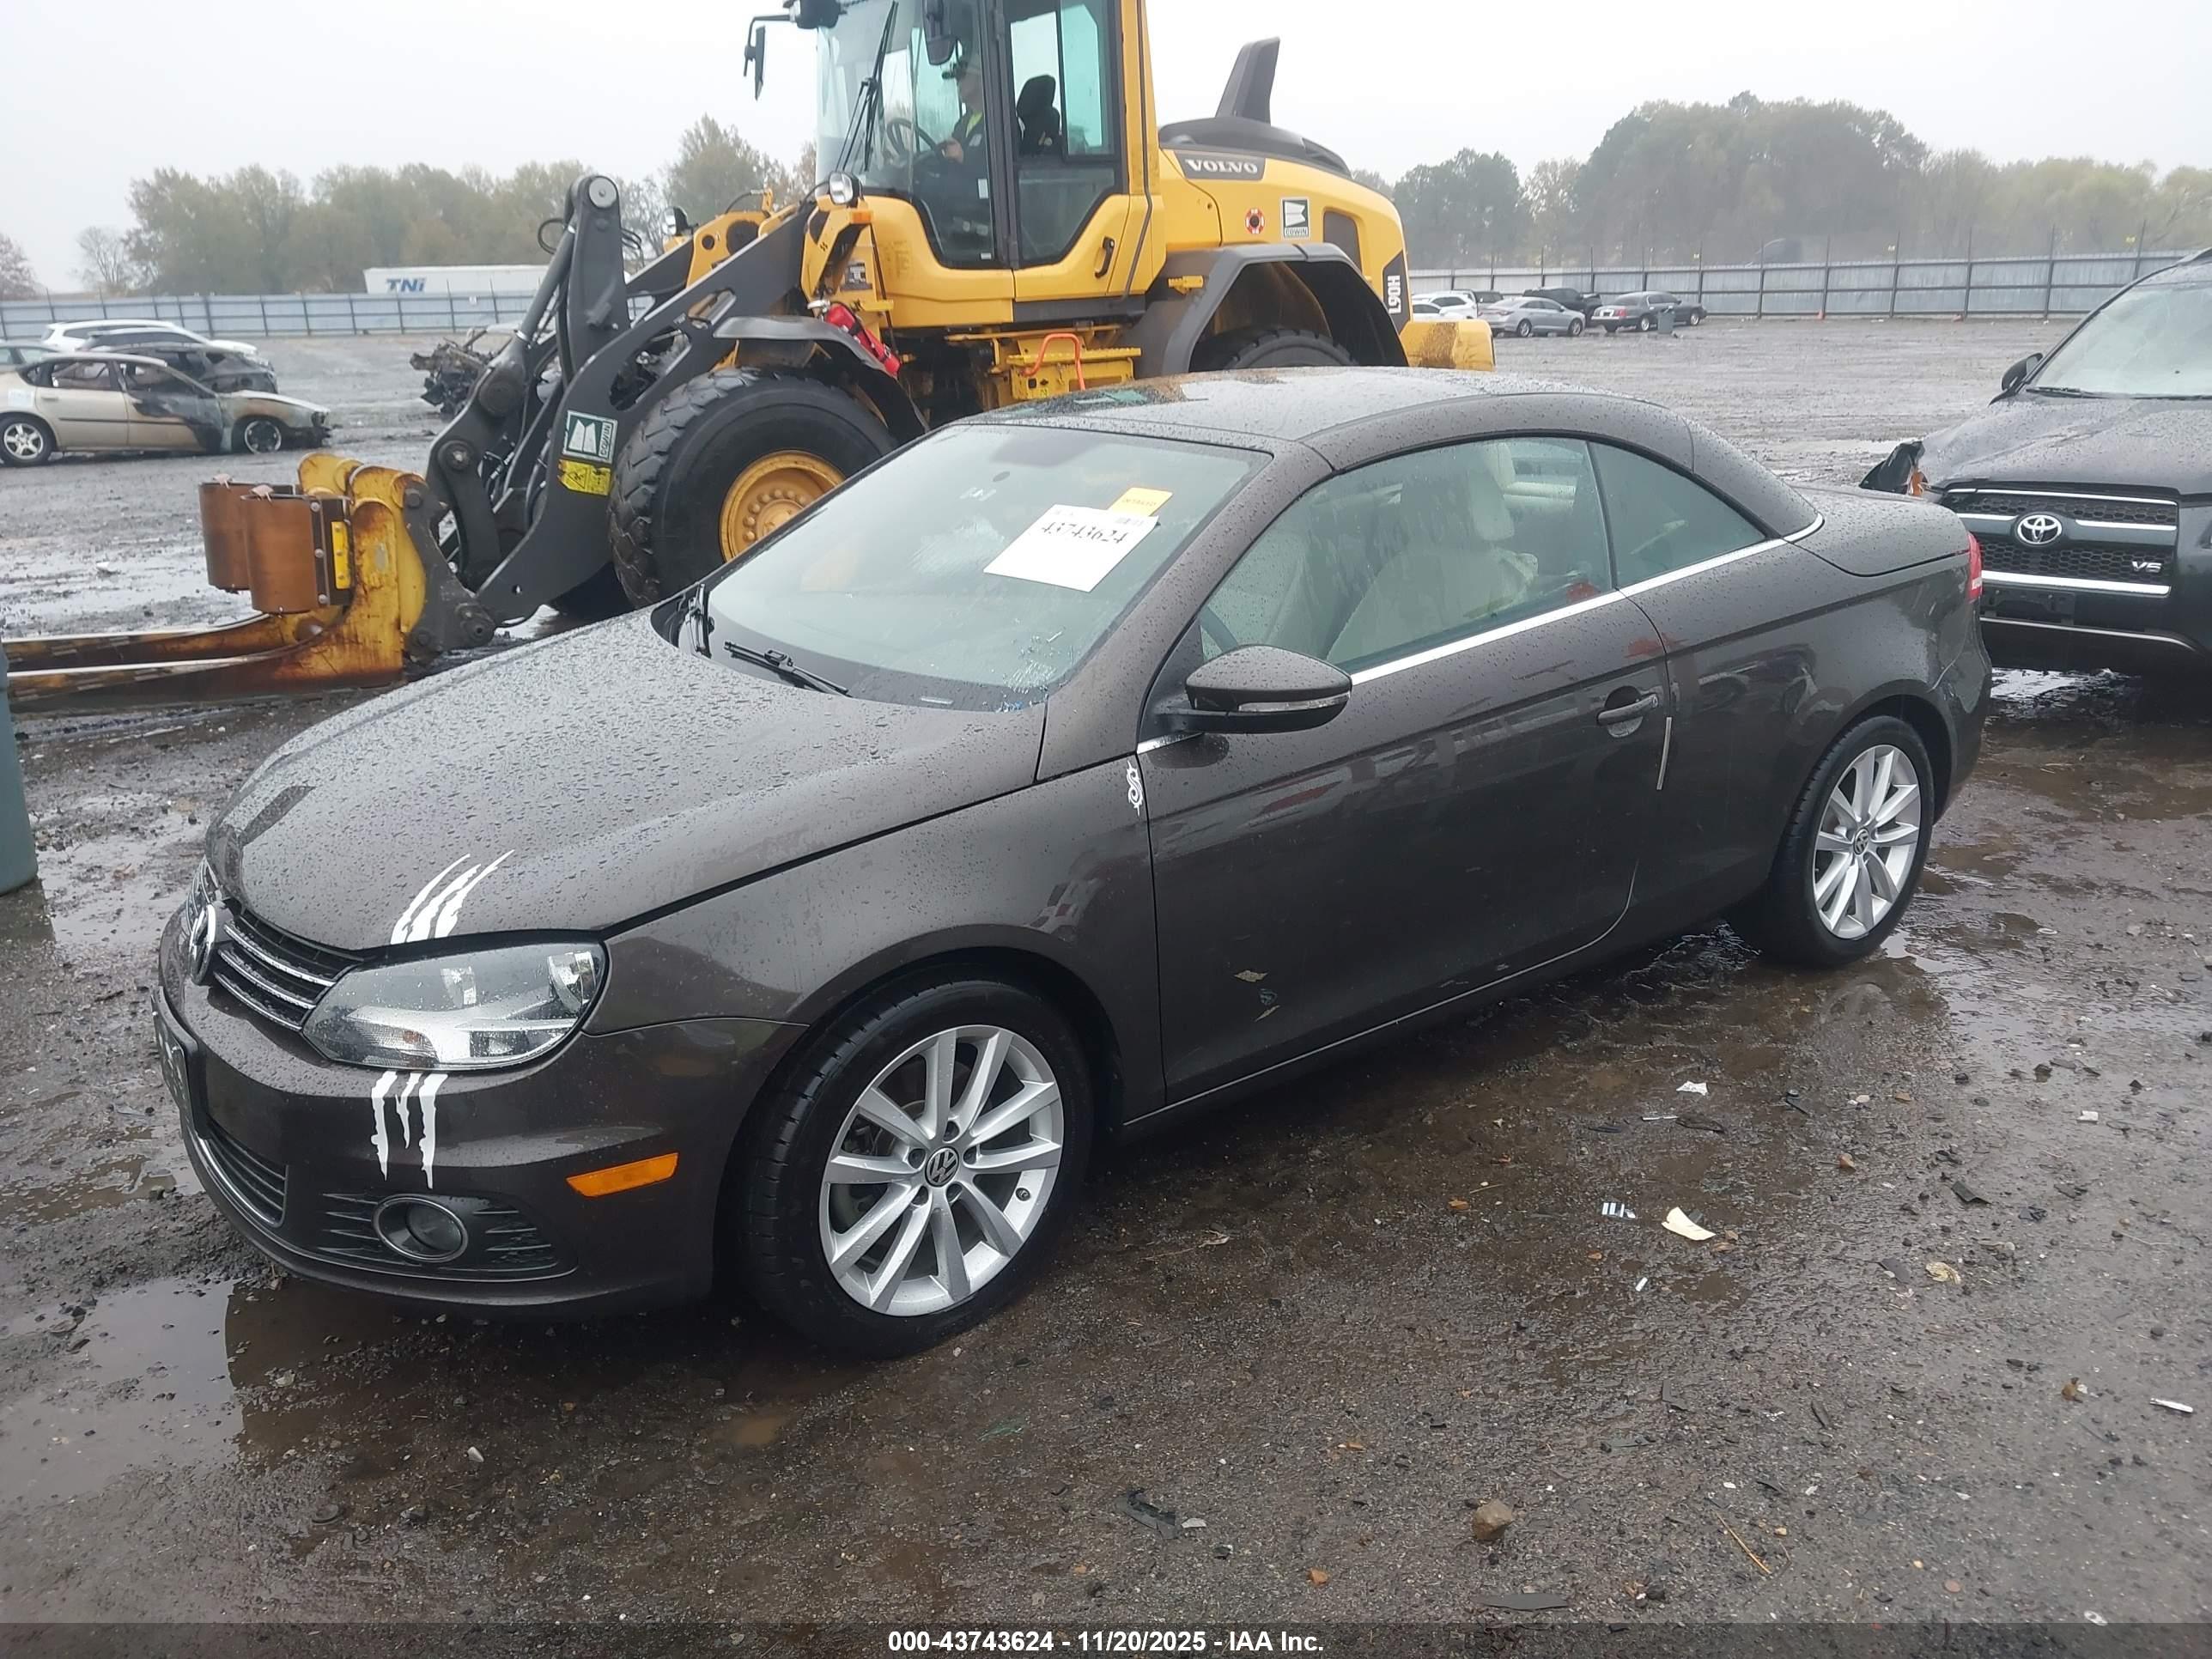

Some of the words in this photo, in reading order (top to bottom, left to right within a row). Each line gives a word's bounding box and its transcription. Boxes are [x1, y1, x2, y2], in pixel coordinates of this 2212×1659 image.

[1185, 159, 1258, 173] VOLVO
[1285, 227, 1308, 236] COWIN
[1388, 275, 1401, 314] L90H
